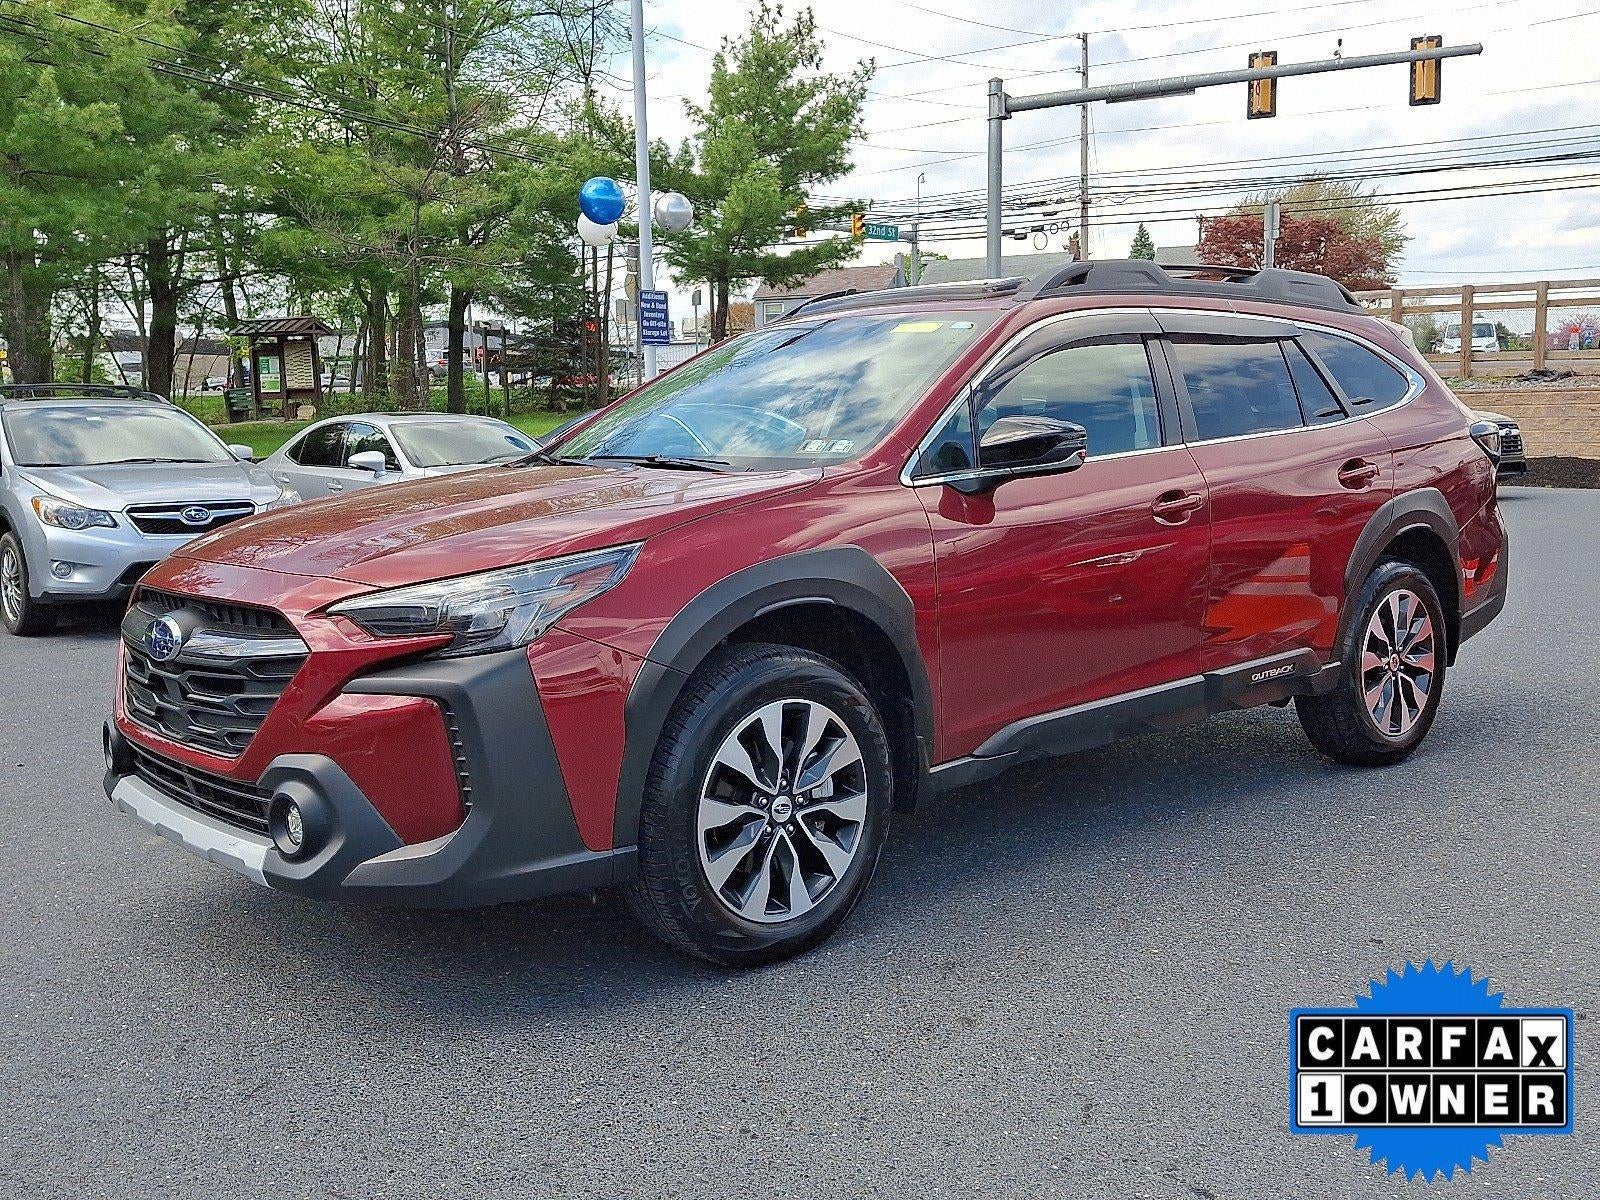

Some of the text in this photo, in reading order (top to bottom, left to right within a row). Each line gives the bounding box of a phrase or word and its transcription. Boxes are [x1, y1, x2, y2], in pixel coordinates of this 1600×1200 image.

[868, 225, 896, 238] 32nd St
[641, 301, 650, 309] New
[643, 311, 664, 319] Inventory
[643, 329, 668, 337] Storage Lot
[1251, 663, 1294, 681] OUTBACK
